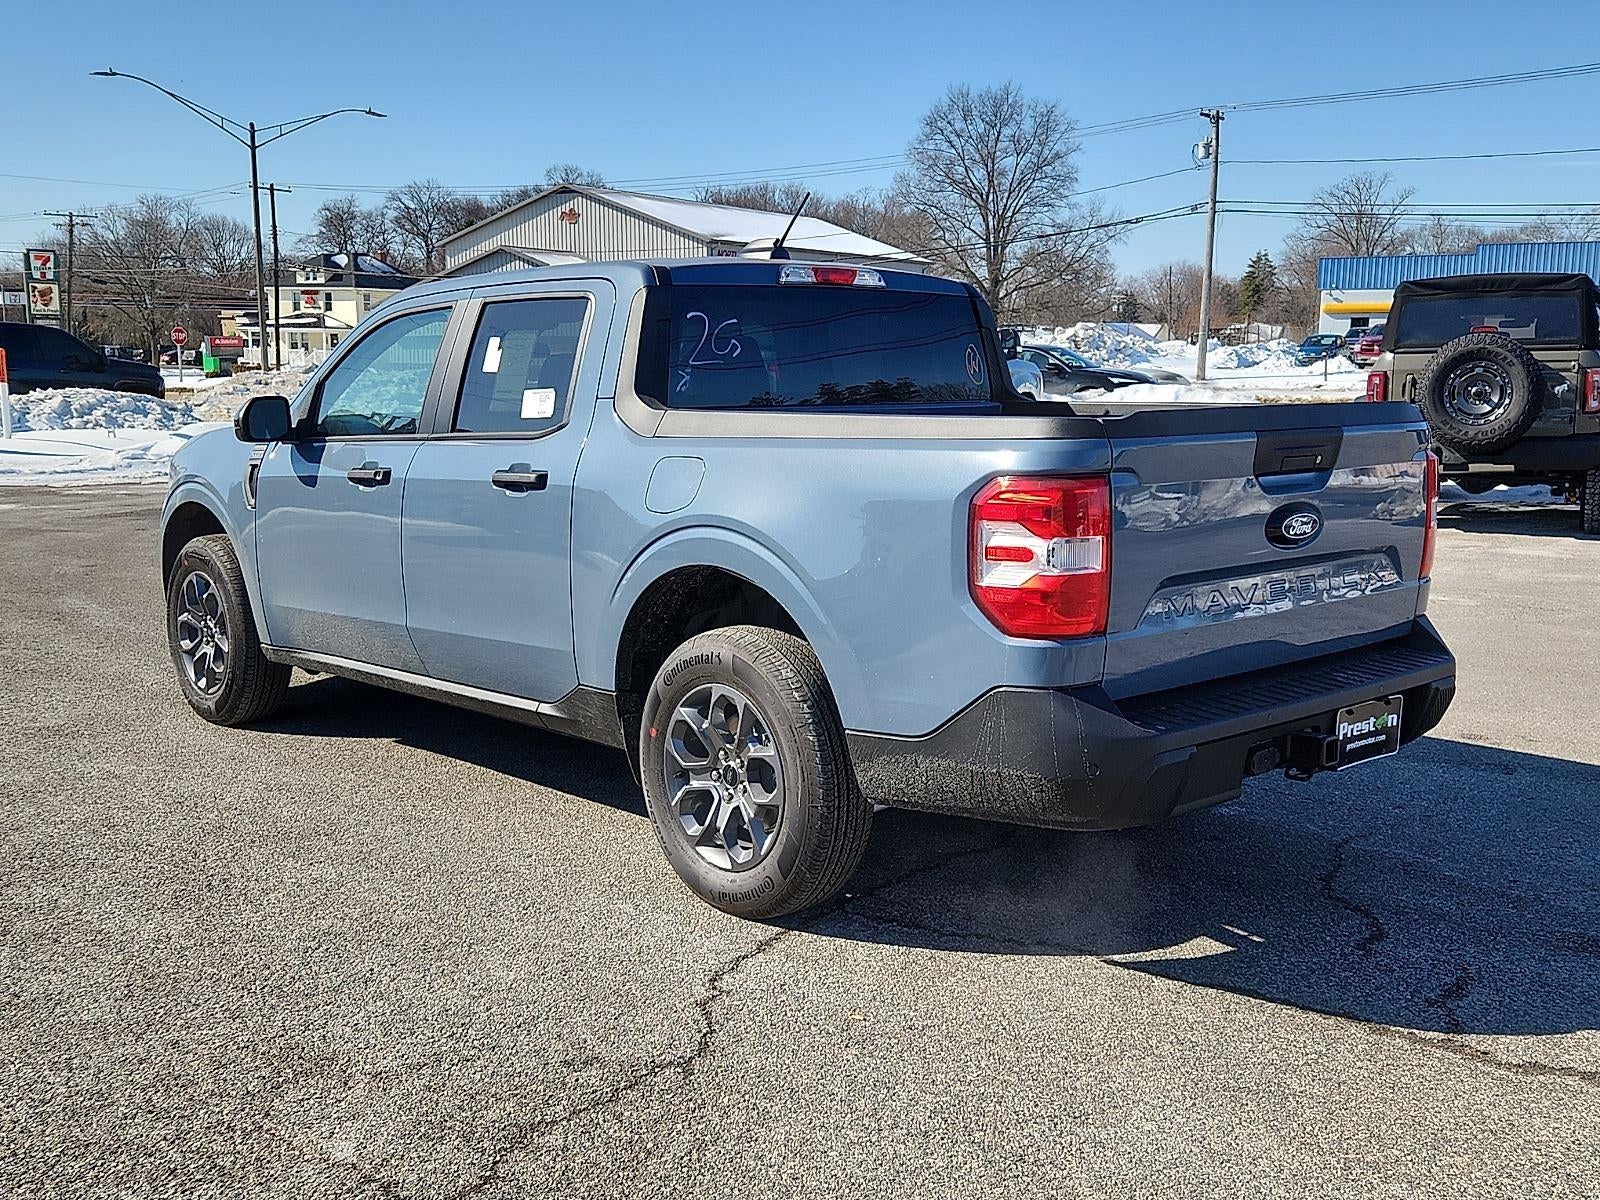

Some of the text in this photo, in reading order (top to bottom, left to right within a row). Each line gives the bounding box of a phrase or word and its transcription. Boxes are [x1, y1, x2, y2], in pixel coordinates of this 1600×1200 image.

[172, 332, 187, 341] STOP
[1286, 516, 1315, 535] Ford
[1162, 560, 1392, 620] MAVERICK
[663, 651, 714, 687] Continental
[1339, 714, 1398, 741] Preston
[718, 875, 776, 904] Continental
